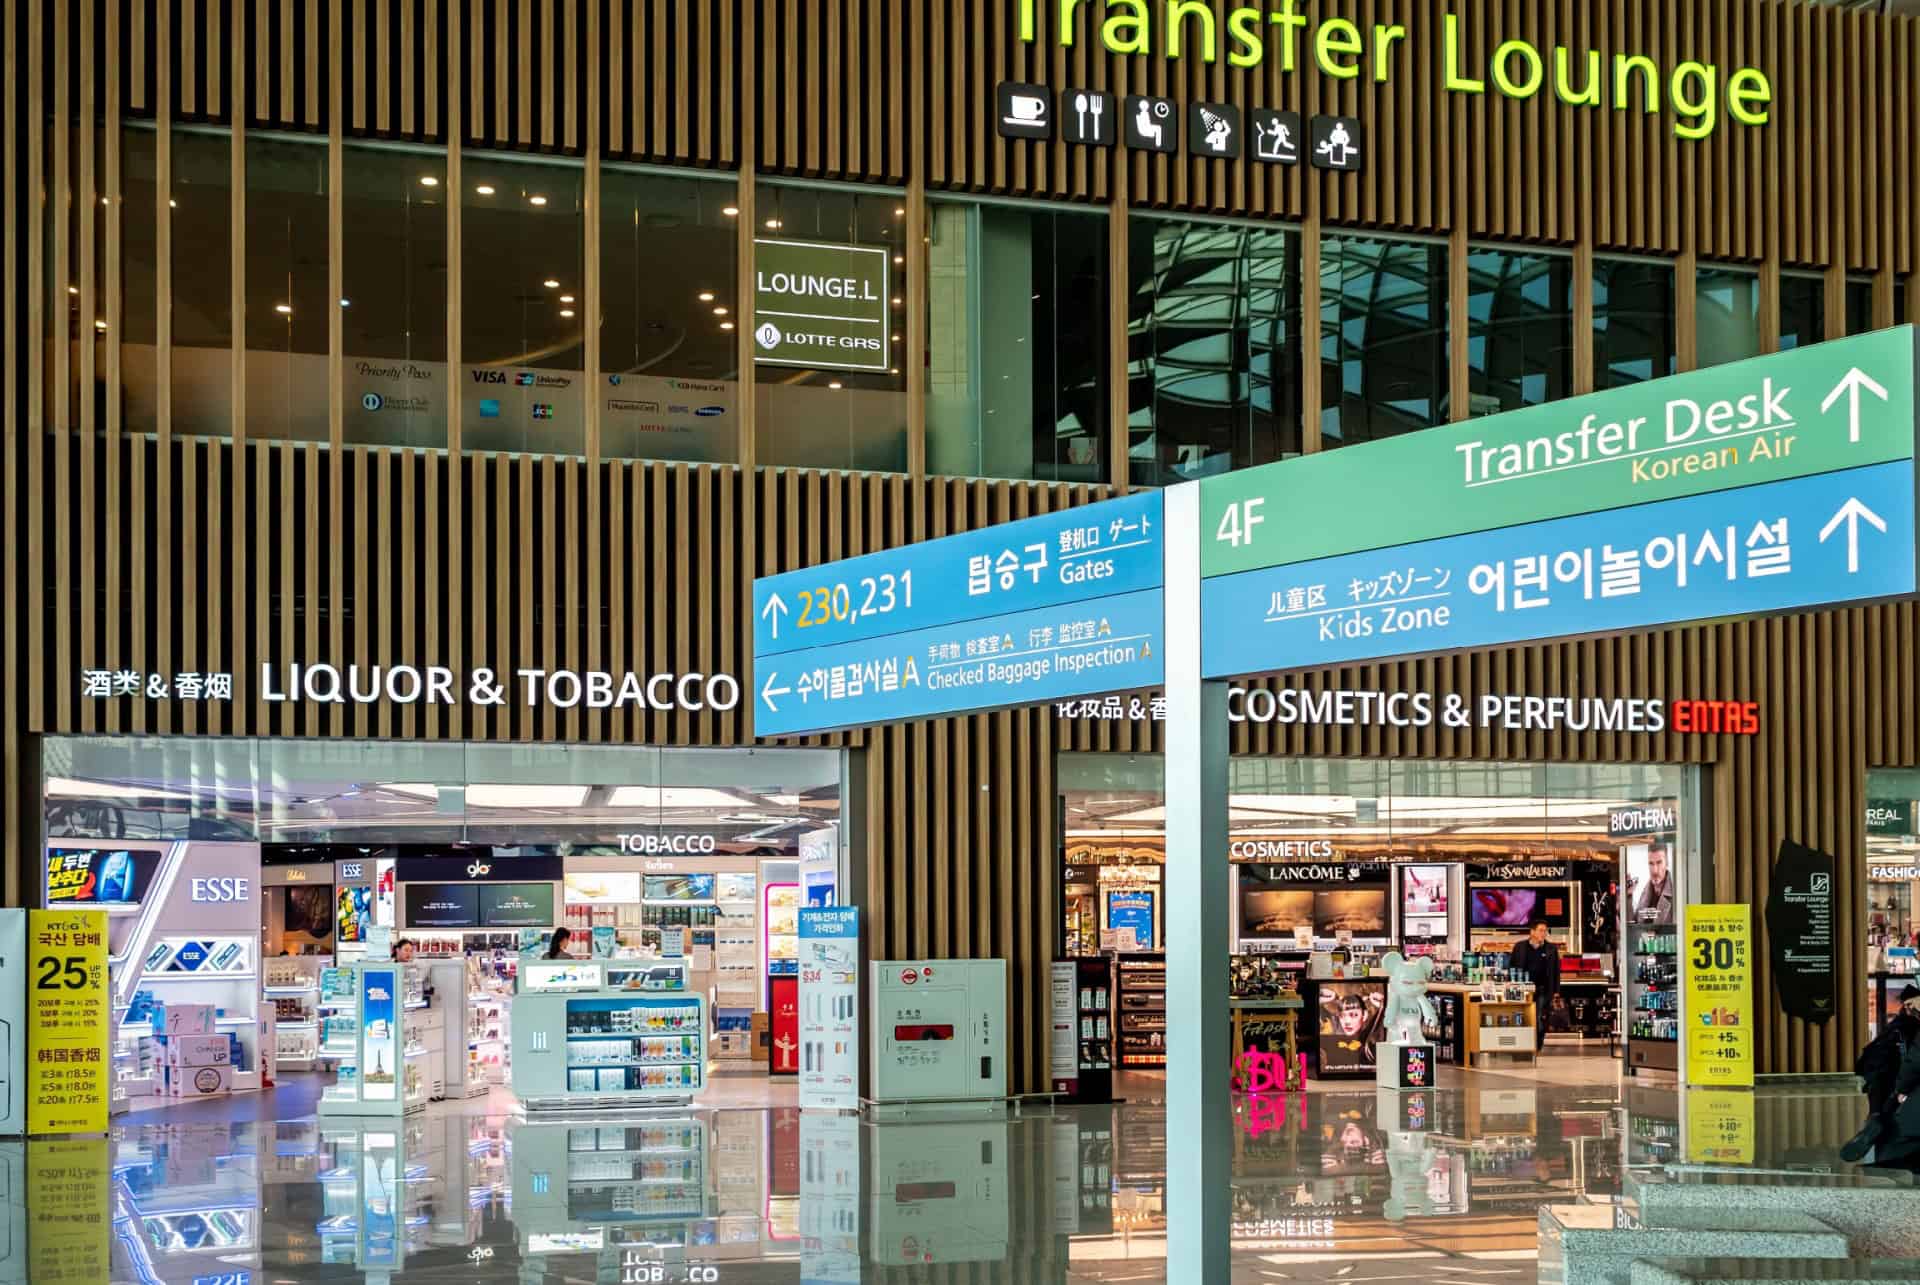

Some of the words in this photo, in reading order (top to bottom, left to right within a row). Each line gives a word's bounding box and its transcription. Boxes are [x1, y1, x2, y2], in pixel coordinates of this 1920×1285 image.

[1443, 13, 1771, 139] Lounge
[757, 271, 878, 300] LOUNGE.L
[785, 332, 837, 347] LOTTE
[839, 336, 881, 350] GRS
[472, 369, 506, 384] VISA
[1456, 413, 1646, 482] Transfer
[1665, 377, 1793, 443] Desk
[1632, 447, 1737, 483] Korean
[1749, 431, 1796, 463] Air
[1109, 513, 1152, 542] ゲート
[1216, 497, 1265, 547] 4F
[1059, 526, 1099, 553] 登机口
[968, 542, 1049, 596] 탑승구
[1059, 559, 1114, 585] Gates
[1468, 517, 1791, 612] 어린이놀이시설
[796, 569, 912, 628] 230,231
[1348, 567, 1451, 601] キッズゾーン
[1266, 583, 1327, 615] 儿童区
[1319, 608, 1373, 641] Kids
[1380, 606, 1450, 634] Zone
[927, 663, 984, 690] Checked
[988, 657, 1050, 685] Baggage
[1054, 644, 1136, 676] Inspection
[1139, 640, 1153, 661] A
[83, 669, 141, 697] 酒类
[146, 673, 169, 699] &
[175, 672, 232, 700] 香烟
[262, 661, 455, 704] LIQUOR
[469, 667, 506, 705] &
[518, 669, 740, 711] TOBACCO
[1128, 698, 1146, 720] &
[1228, 688, 1431, 727] COSMETICS
[1444, 693, 1471, 727] &
[1480, 695, 1665, 732] PERFUMES
[1671, 699, 1760, 734] ENTAS
[1611, 807, 1673, 832] BIOTHERM
[616, 834, 715, 853] TOBACCO
[1231, 841, 1332, 857] COSMETICS
[343, 863, 362, 878] ESSE
[466, 859, 490, 878] glo
[1269, 865, 1344, 881] LANCÔME
[1872, 866, 1920, 878] FASHIO
[191, 878, 249, 902] ESSE
[38, 932, 67, 946] 국산
[73, 932, 100, 946] 담배
[1693, 938, 1733, 969] 30
[182, 951, 201, 961] ESSE
[37, 956, 87, 989] 25
[38, 1047, 101, 1063] 韩国香烟
